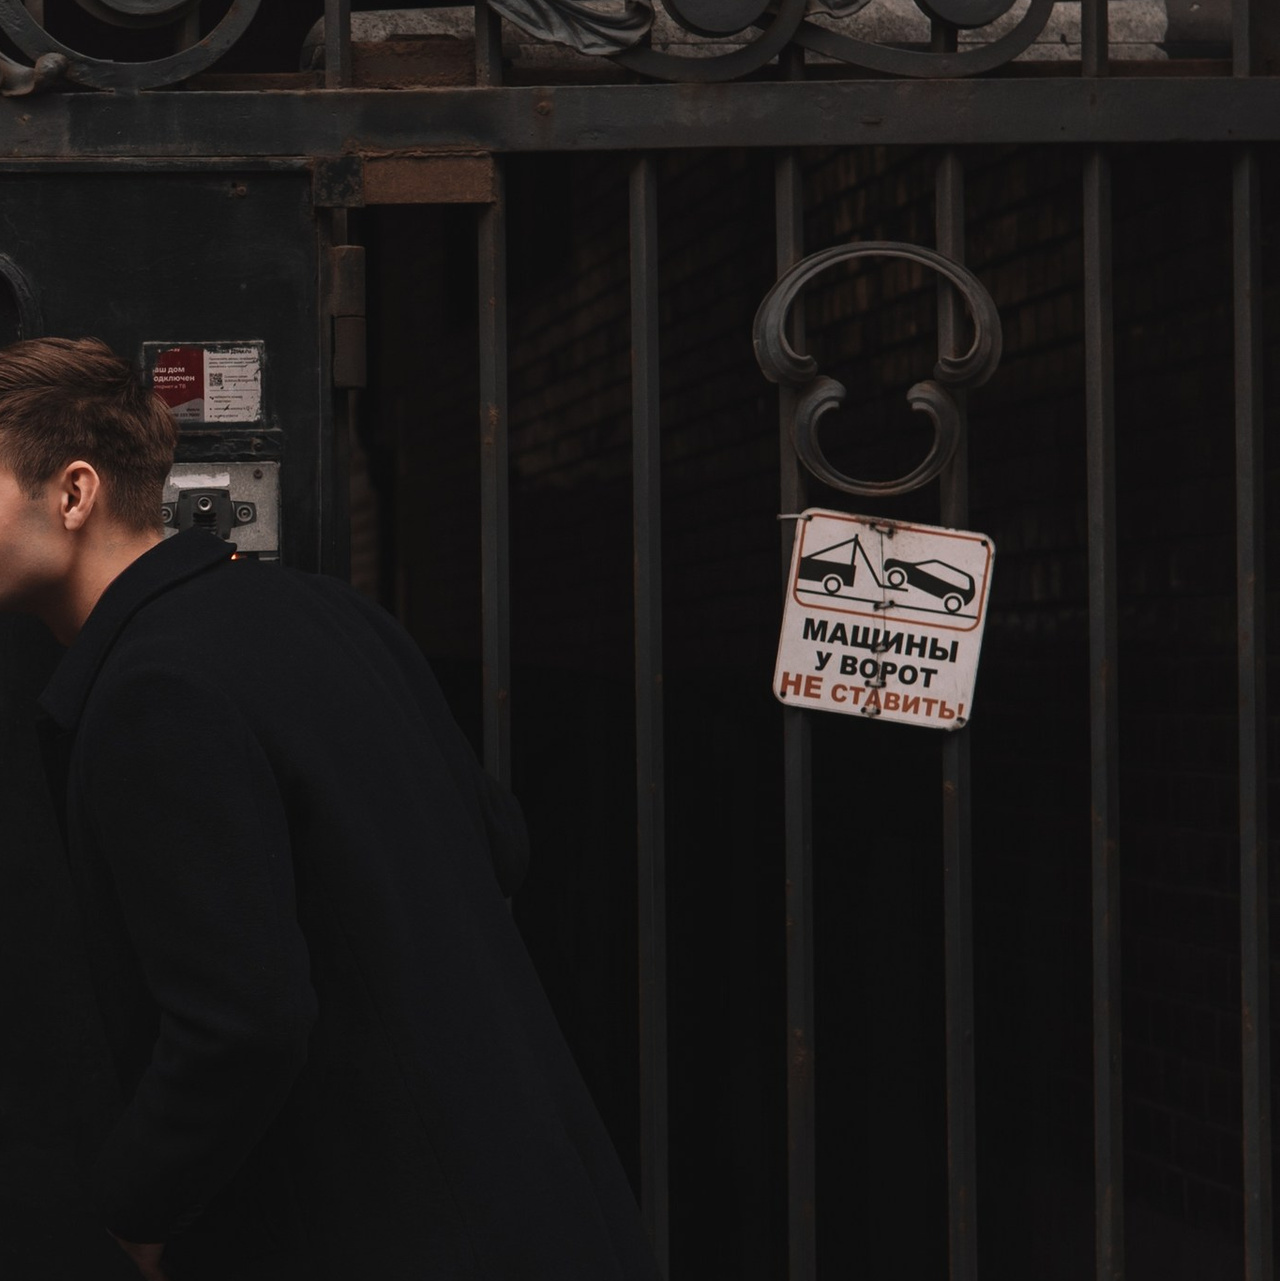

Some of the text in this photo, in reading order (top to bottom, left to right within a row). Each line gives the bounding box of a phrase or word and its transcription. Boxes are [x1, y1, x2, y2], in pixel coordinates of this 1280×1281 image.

[153, 375, 195, 383] одключен
[167, 366, 185, 374] дом
[802, 617, 959, 663] МАШИНЫ
[814, 650, 938, 688] У ВОРОТ
[780, 671, 965, 720] НЕ СТАВИТЬ!
